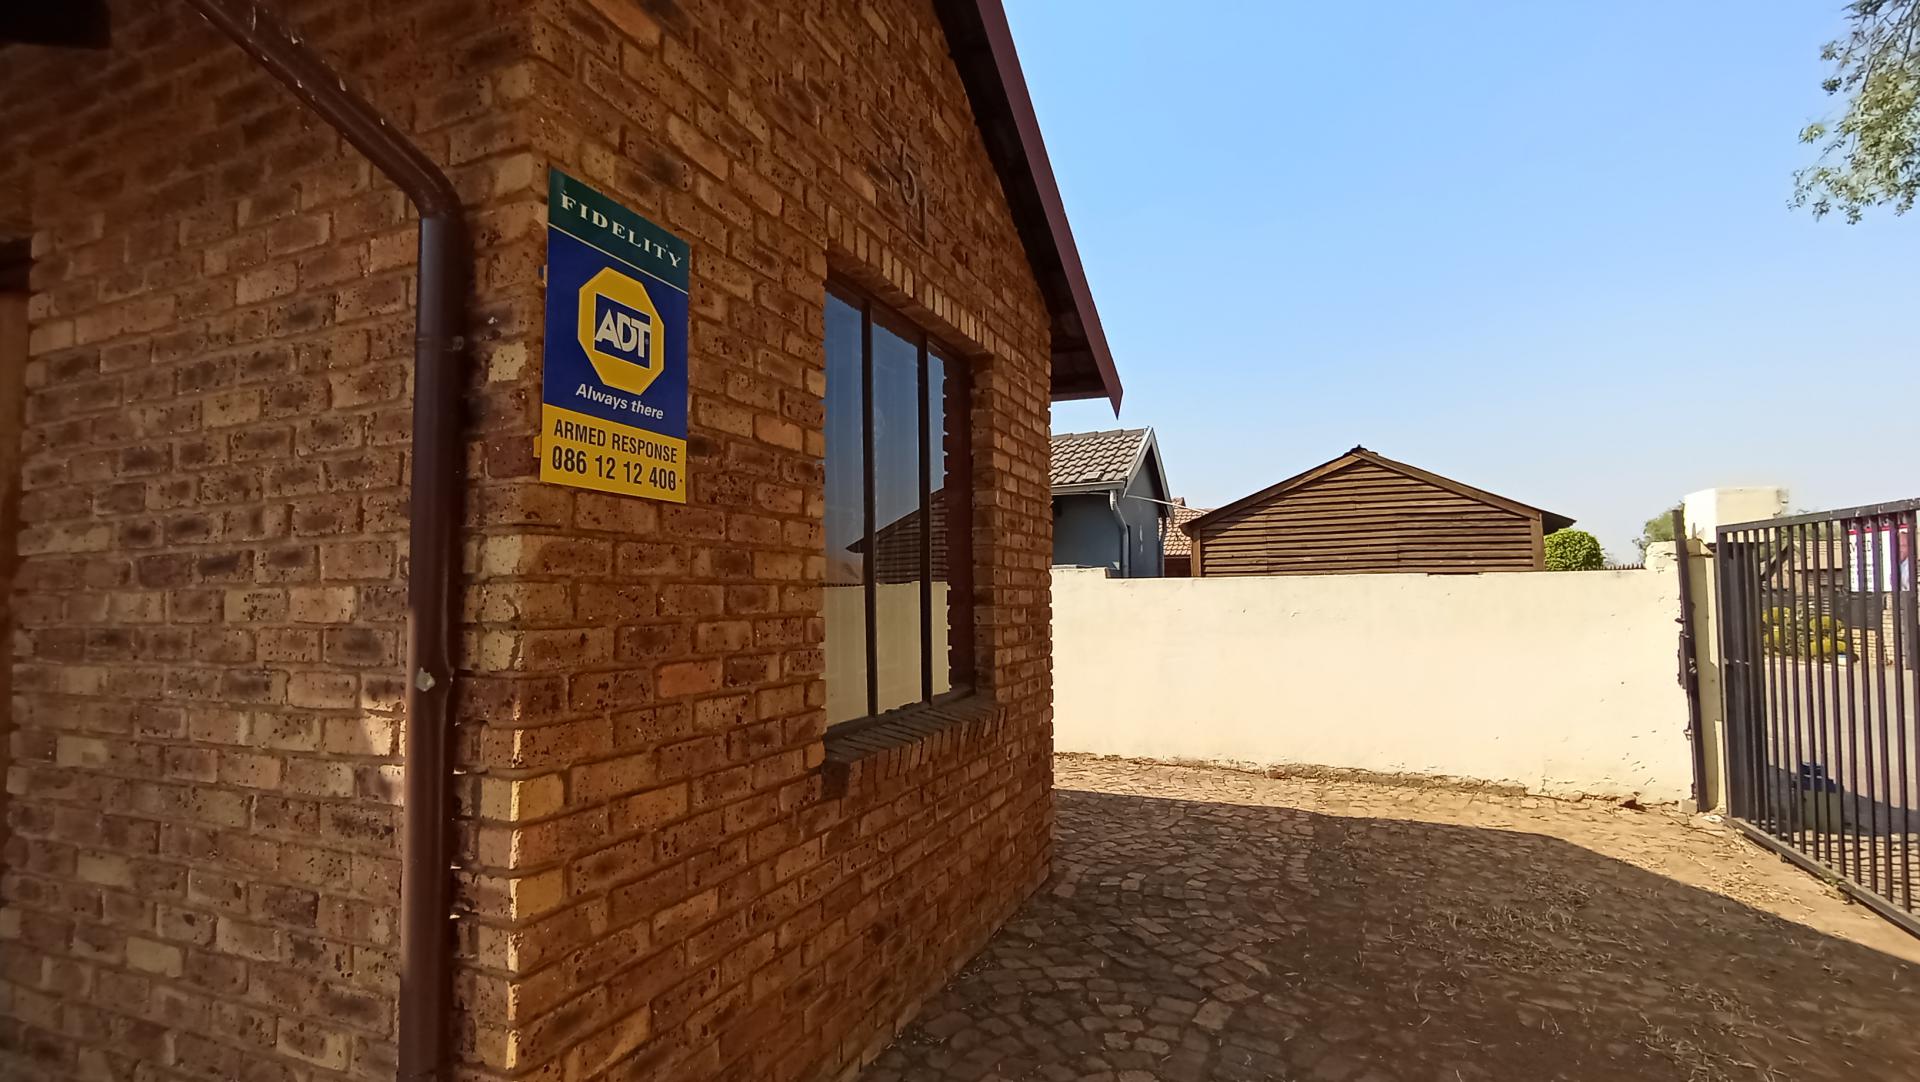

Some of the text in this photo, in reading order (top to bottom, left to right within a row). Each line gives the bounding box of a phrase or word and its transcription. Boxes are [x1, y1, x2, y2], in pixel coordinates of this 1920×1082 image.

[560, 192, 681, 268] FIDELITY
[595, 308, 652, 358] ADT
[575, 383, 664, 420] Always there
[553, 419, 678, 463] ARMED RESPONSE
[552, 445, 677, 492] 086 12 12 400
